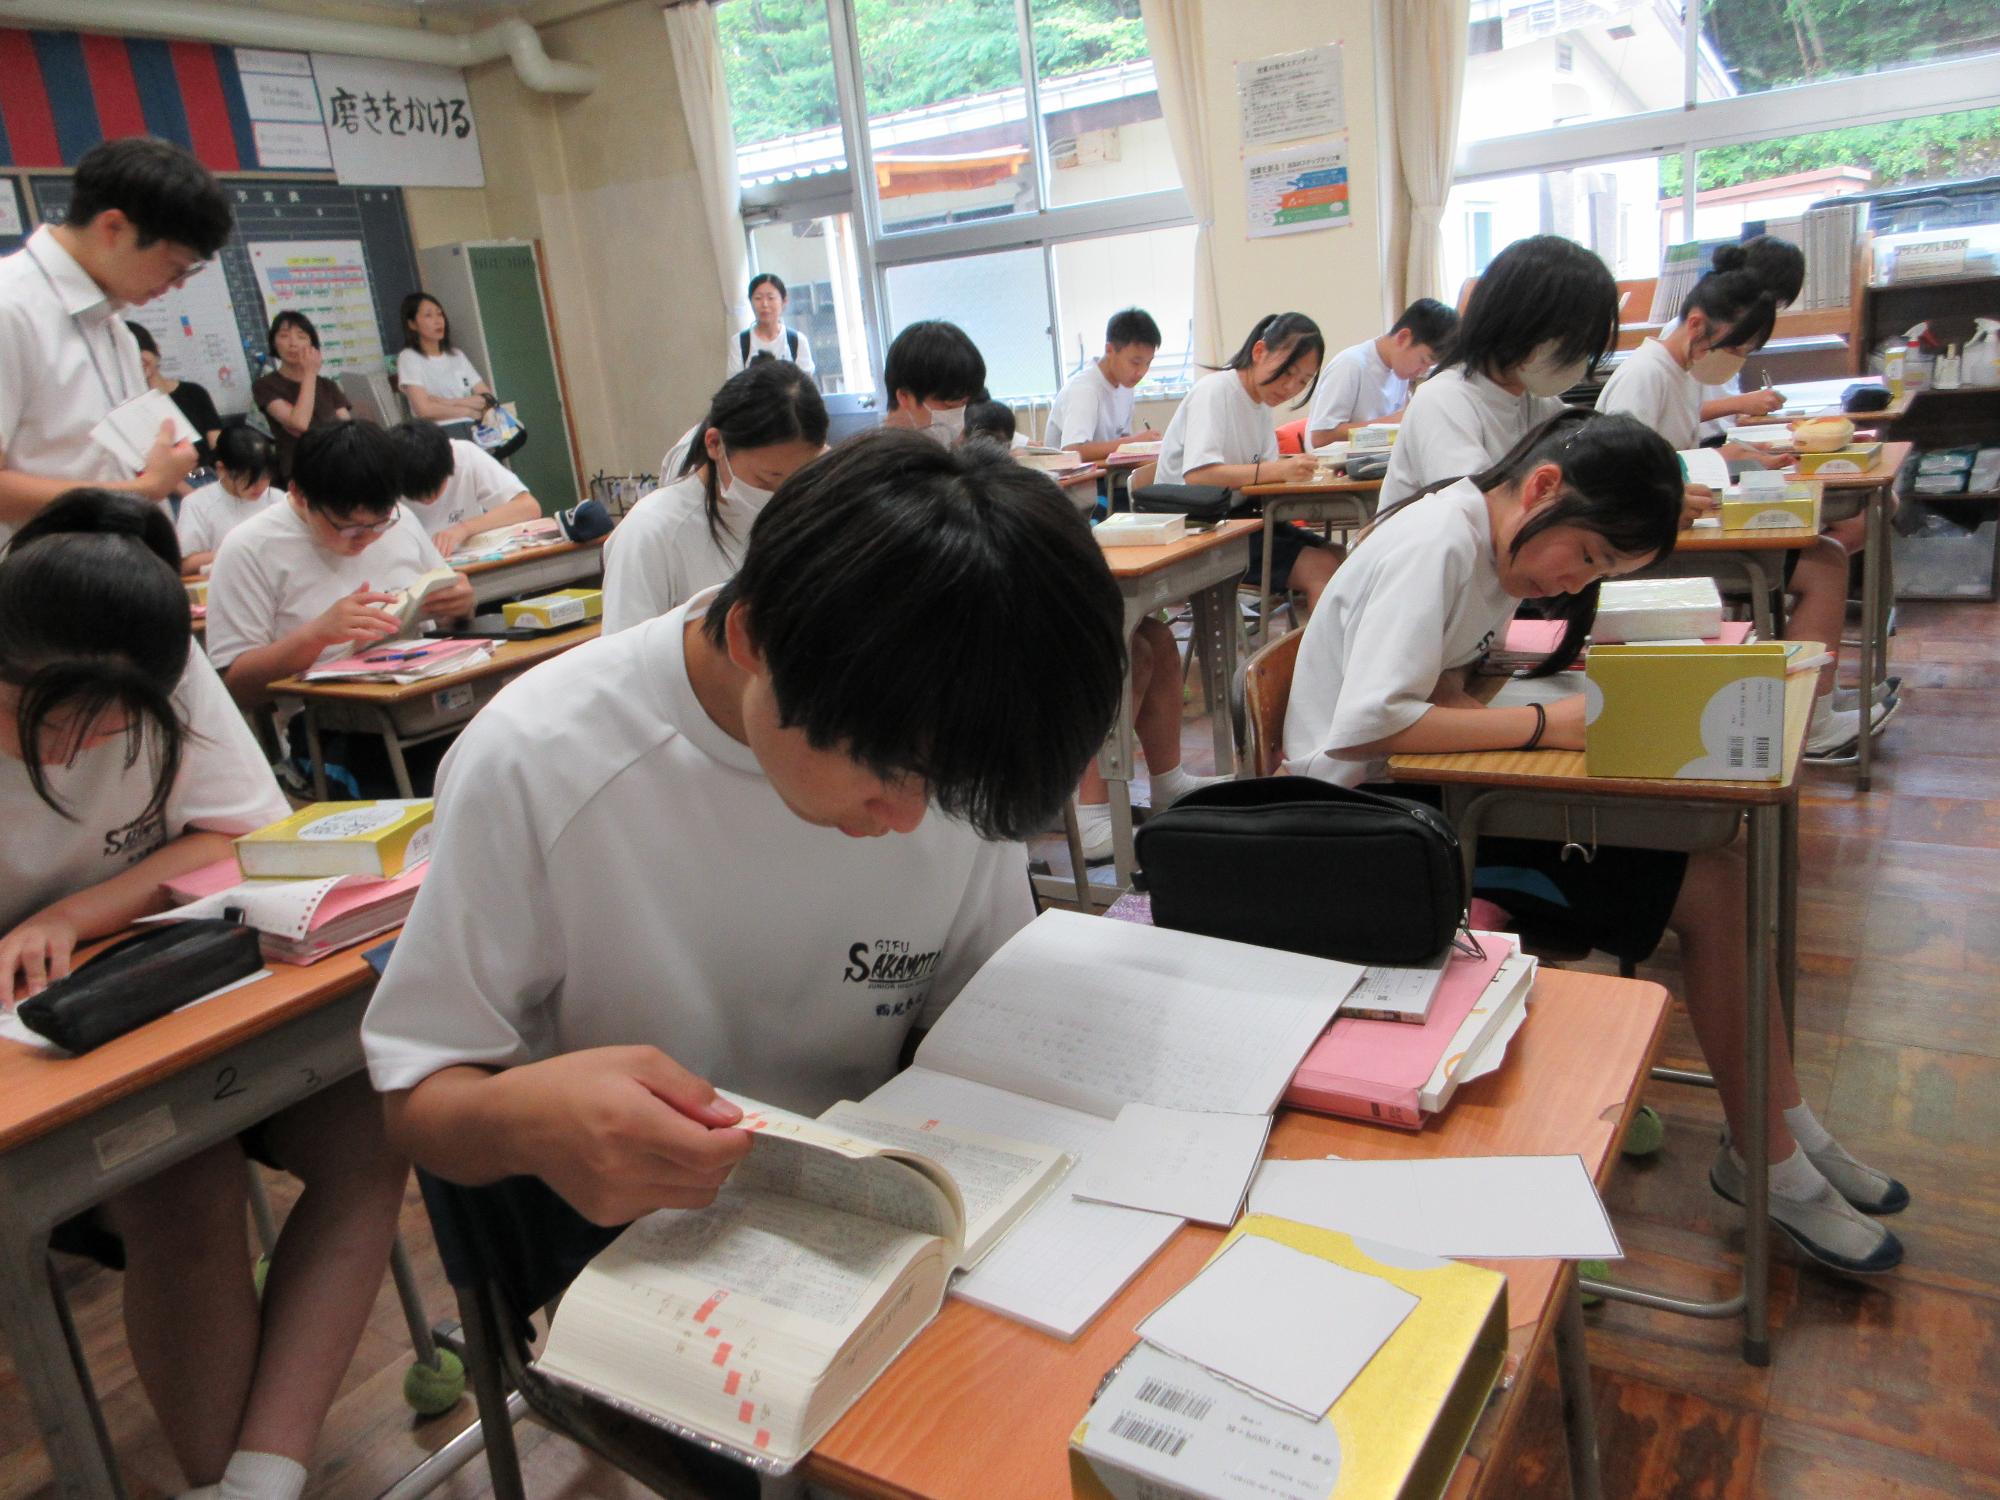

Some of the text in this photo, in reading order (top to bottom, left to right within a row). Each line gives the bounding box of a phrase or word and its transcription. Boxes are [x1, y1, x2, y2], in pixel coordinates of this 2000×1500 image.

[331, 85, 471, 141] 磨きをかける
[875, 938, 910, 953] GIFU
[214, 1066, 246, 1102] 2
